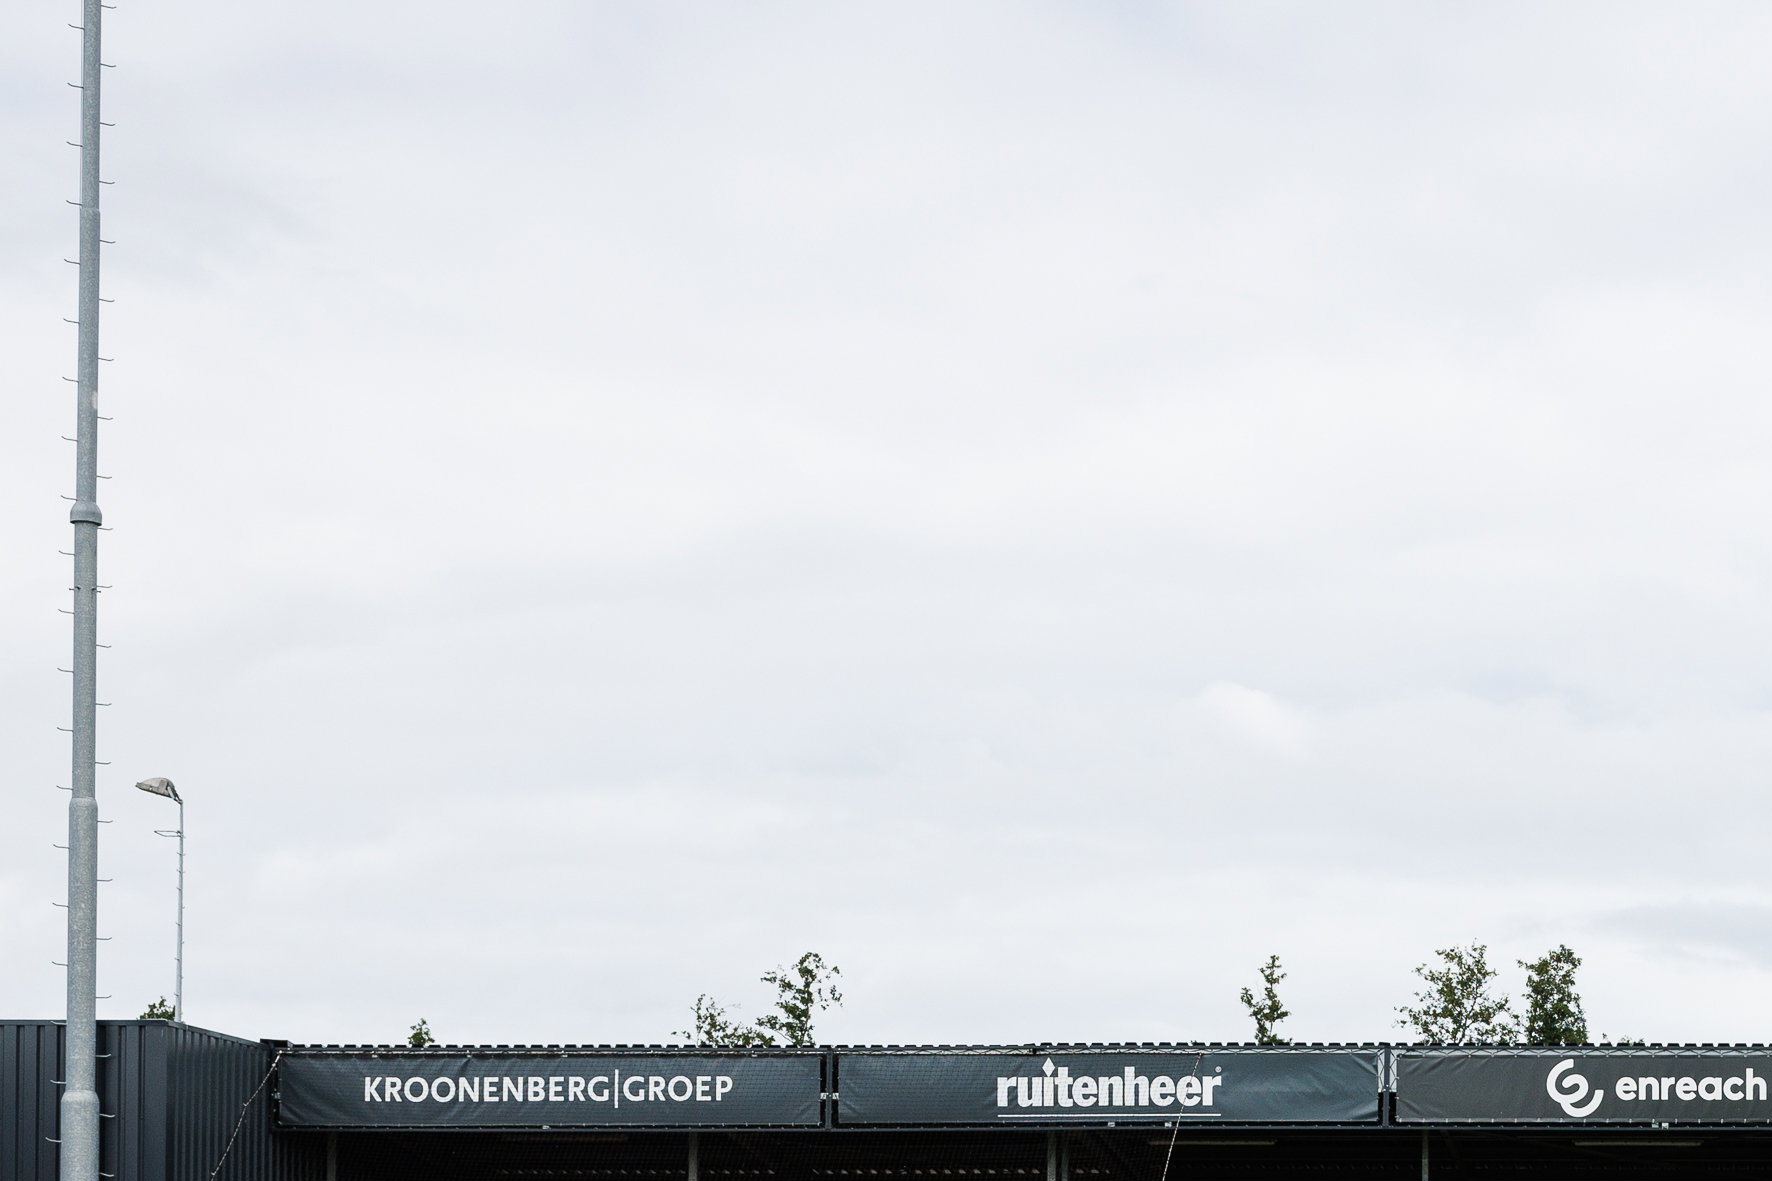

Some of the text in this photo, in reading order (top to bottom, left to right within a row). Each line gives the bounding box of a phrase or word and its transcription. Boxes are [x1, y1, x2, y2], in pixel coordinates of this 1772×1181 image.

[364, 1075, 733, 1103] KROONENBERG GROEP
[996, 1056, 1222, 1107] ruitenheer
[1615, 1067, 1768, 1101] enreach
